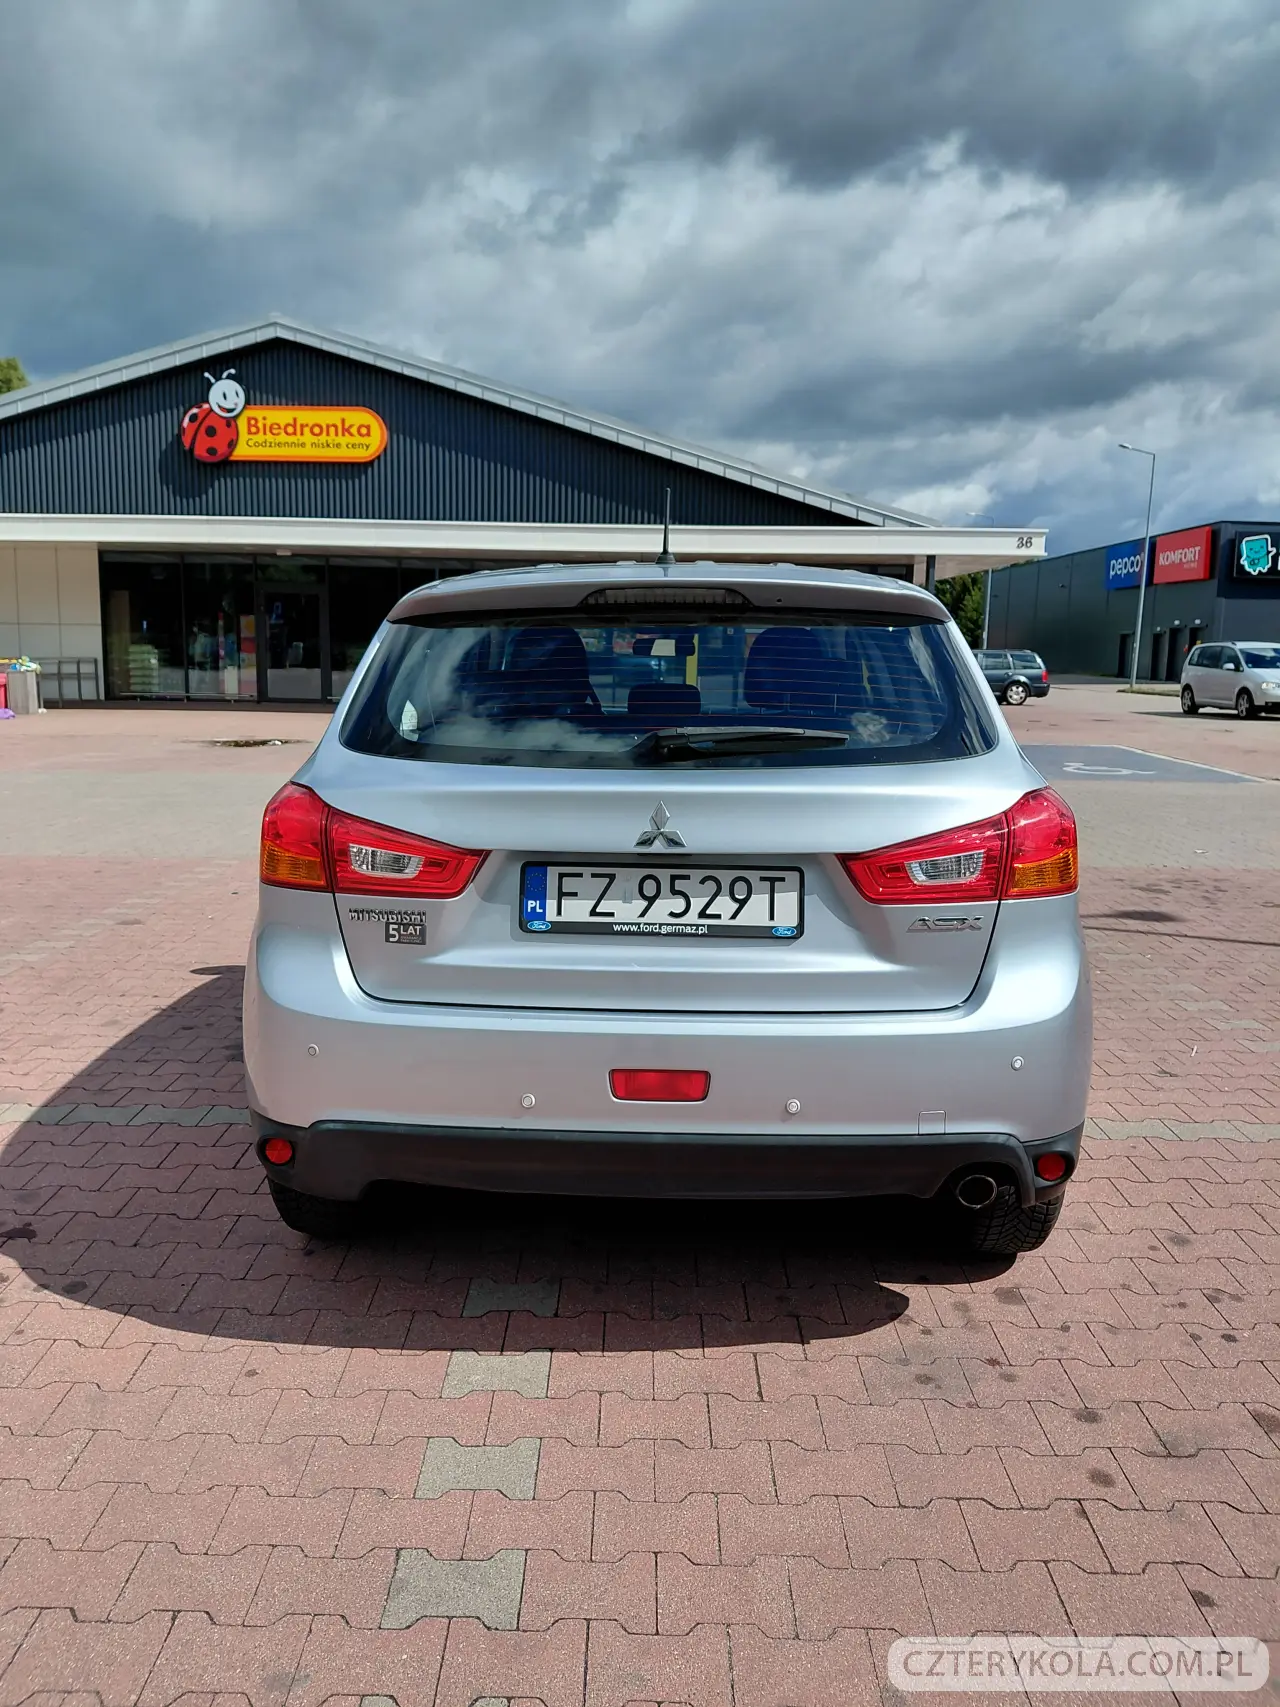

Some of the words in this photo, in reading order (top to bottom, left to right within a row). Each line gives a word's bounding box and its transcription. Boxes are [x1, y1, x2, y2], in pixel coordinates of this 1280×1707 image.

[246, 416, 371, 437] Biedronka
[246, 438, 306, 448] Codziennie
[310, 439, 341, 449] niskie
[346, 442, 371, 451] ceny
[1159, 546, 1201, 565] KOMFORT
[1109, 554, 1141, 579] pepco
[556, 872, 617, 918] FZ
[637, 873, 786, 921] 9529T
[527, 900, 543, 912] PL
[348, 908, 427, 923] MITSUBISHI
[389, 924, 399, 942] 5
[400, 925, 422, 935] LAT
[613, 923, 708, 934] www.ford.germaz.pl
